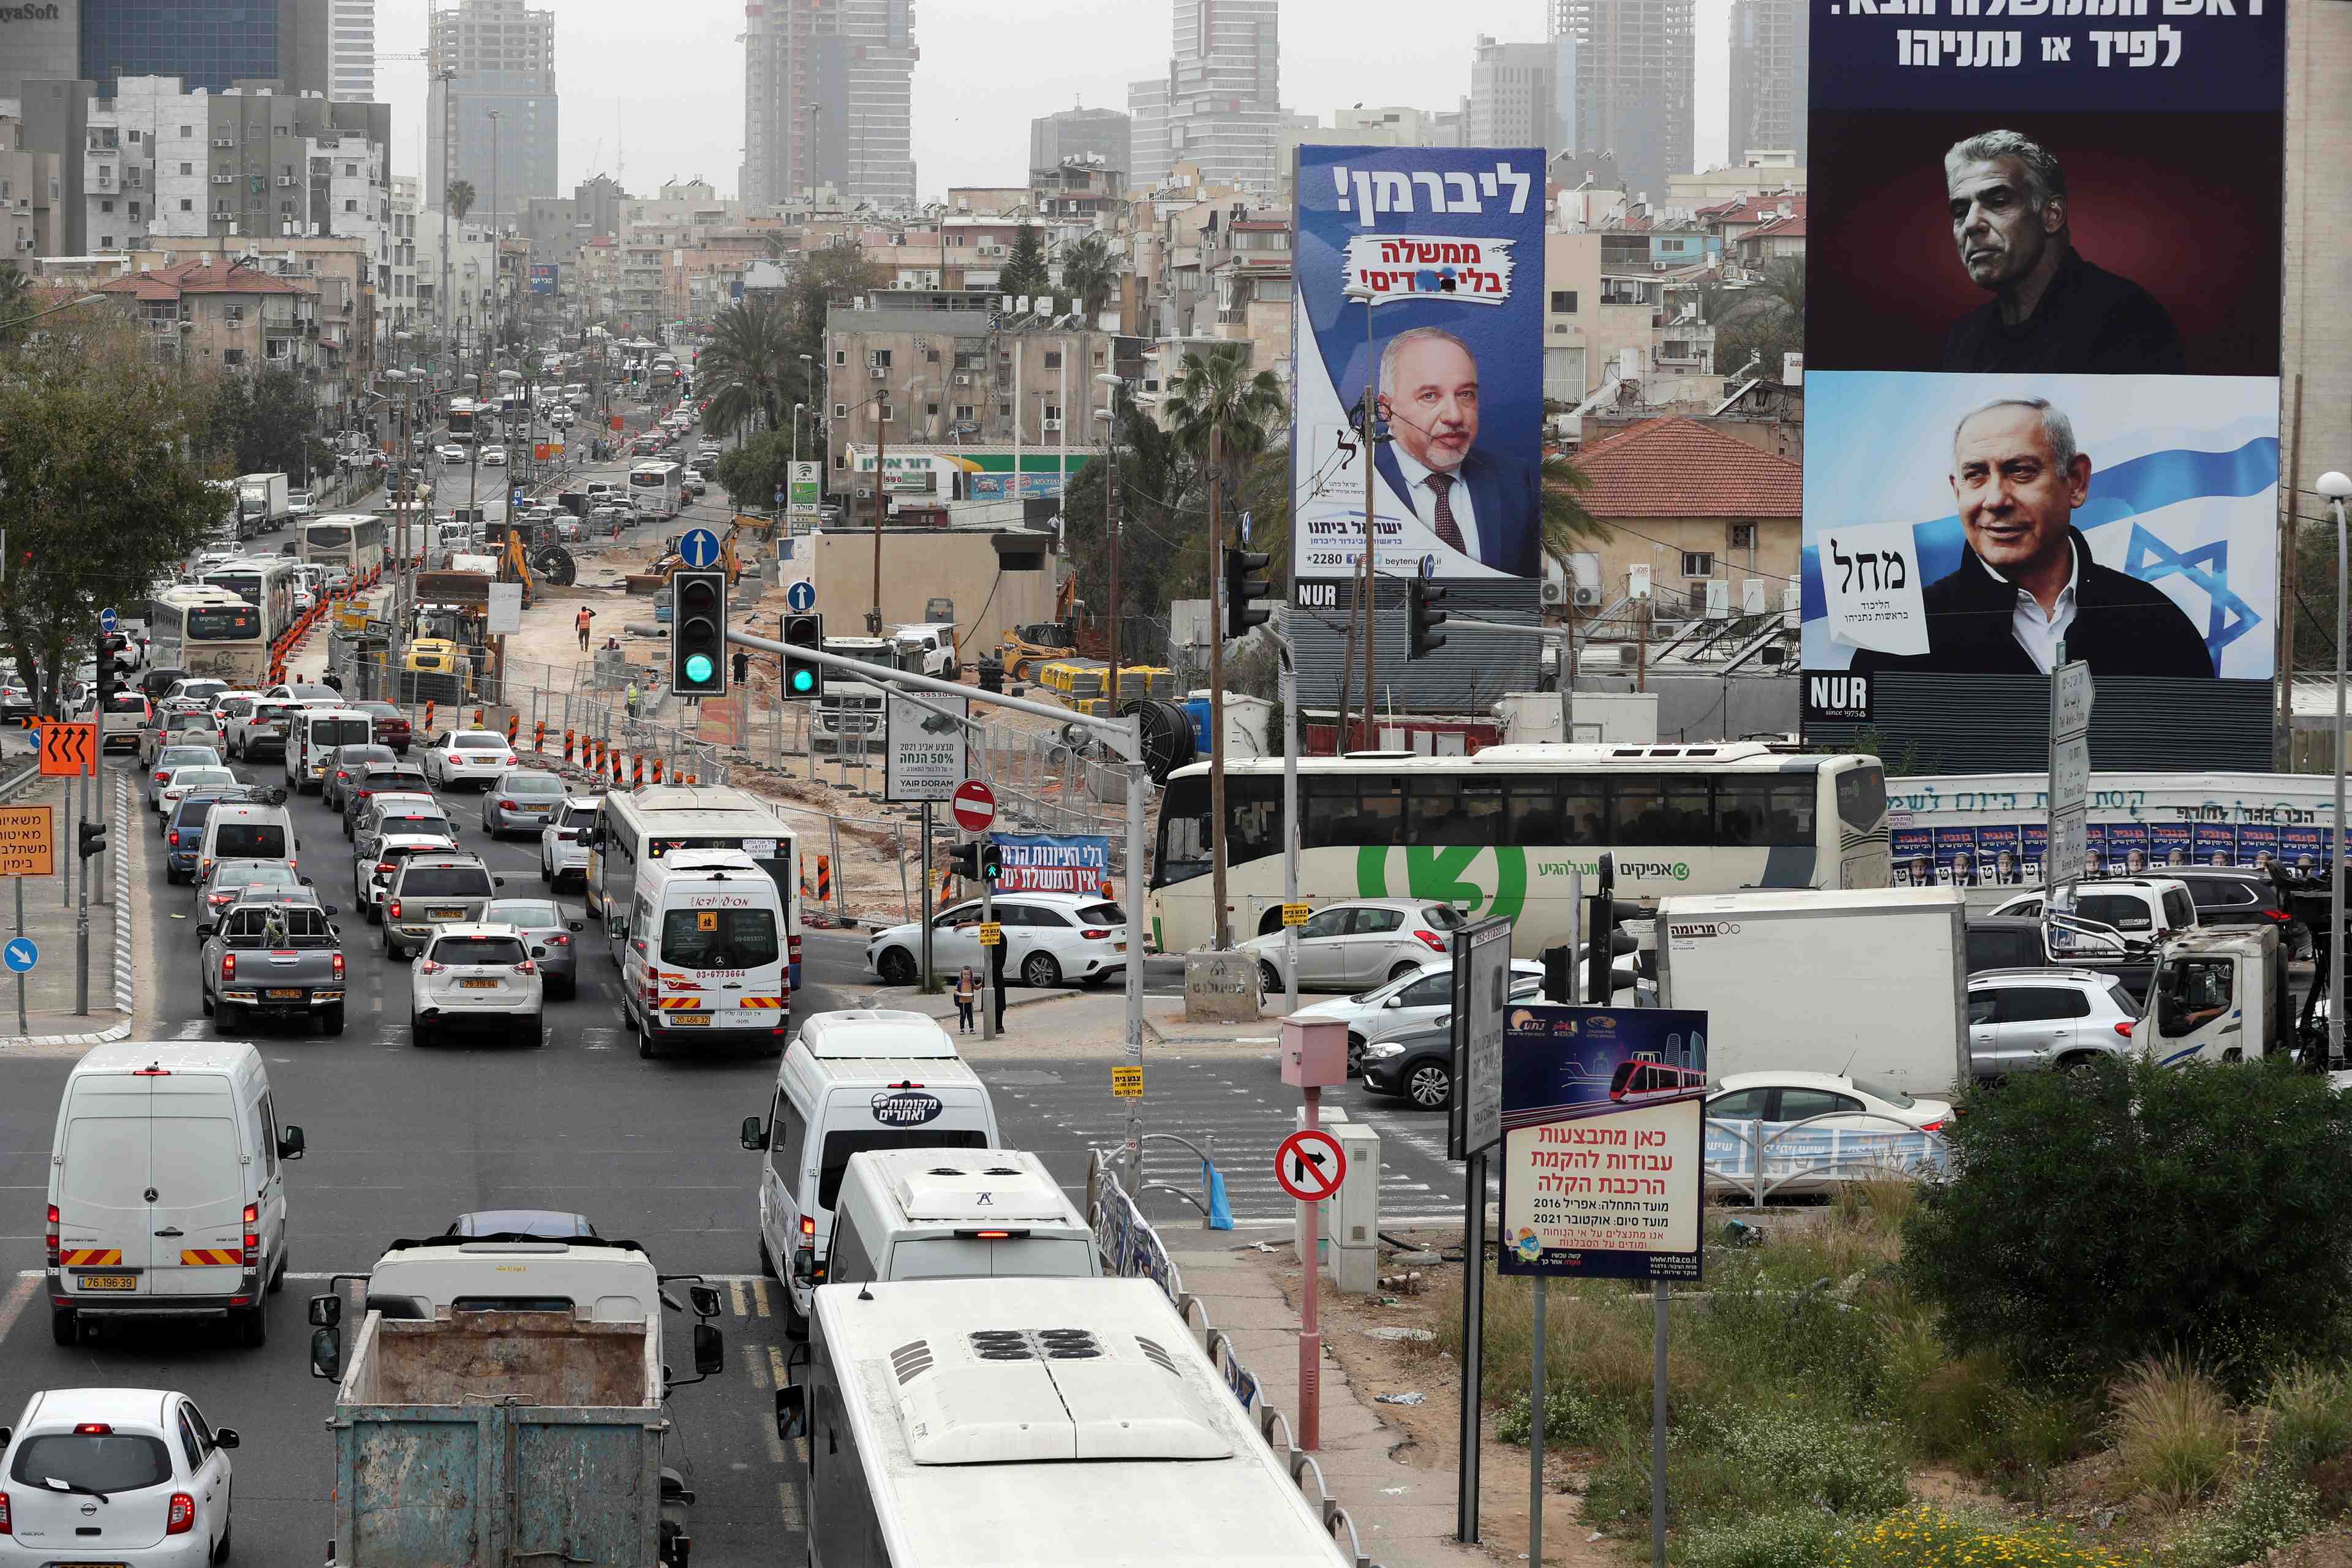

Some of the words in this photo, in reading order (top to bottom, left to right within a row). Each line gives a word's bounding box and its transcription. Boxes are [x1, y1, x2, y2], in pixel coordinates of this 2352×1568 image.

[1897, 29, 2021, 67] נתניהו
[2041, 37, 2071, 61] או
[2089, 24, 2182, 67] לפיד
[1333, 163, 1531, 227] ליברמן!
[1381, 238, 1481, 264] ממשלה
[1458, 268, 1502, 292] בלי
[905, 458, 931, 468] דור
[1308, 521, 1348, 534] ביתנו
[1831, 538, 1905, 594] מחל
[1299, 585, 1335, 605] NUR
[1861, 600, 1890, 610] הליכוד
[1845, 613, 1872, 623] נתניהו
[1875, 611, 1909, 621] בראשות
[1811, 677, 1867, 709] NUR
[900, 753, 927, 764] הנחה
[931, 753, 954, 764] 50%
[0, 816, 40, 826] משאיו
[1033, 846, 1080, 867] הציונות
[1083, 845, 1104, 867] בלי
[4, 859, 33, 870] בימין
[1538, 859, 1578, 876] להגיע
[1022, 866, 1073, 890] ממשלת
[1076, 870, 1097, 892] אין
[1670, 924, 1716, 935] מריומה
[888, 1098, 937, 1112] מקומות
[879, 1109, 926, 1121] ואתרים
[1539, 1126, 1627, 1147] מתבצעות
[1634, 1129, 1666, 1149] כאן
[1531, 1150, 1600, 1171] להקמת
[1607, 1153, 1673, 1172] עבודות
[1538, 1173, 1591, 1196] הקלה
[1599, 1177, 1665, 1194] הרכבת
[1534, 1198, 1561, 1208] 2016
[1563, 1198, 1596, 1210] אפריל
[1599, 1199, 1640, 1210] התחלה:
[1642, 1200, 1668, 1212] מועד
[1534, 1214, 1561, 1224] 2021
[1564, 1215, 1610, 1227] אוקטובר
[1614, 1216, 1638, 1226] סיום:
[1642, 1218, 1668, 1227] מועד
[1543, 1228, 1574, 1237] הנוחות
[1578, 1229, 1587, 1238] אי
[1591, 1229, 1602, 1238] על
[1607, 1230, 1646, 1239] מתנצלים
[1559, 1238, 1599, 1248] הסבלנות
[1603, 1239, 1614, 1248] על
[1650, 1255, 1697, 1264] www.nta.co.il
